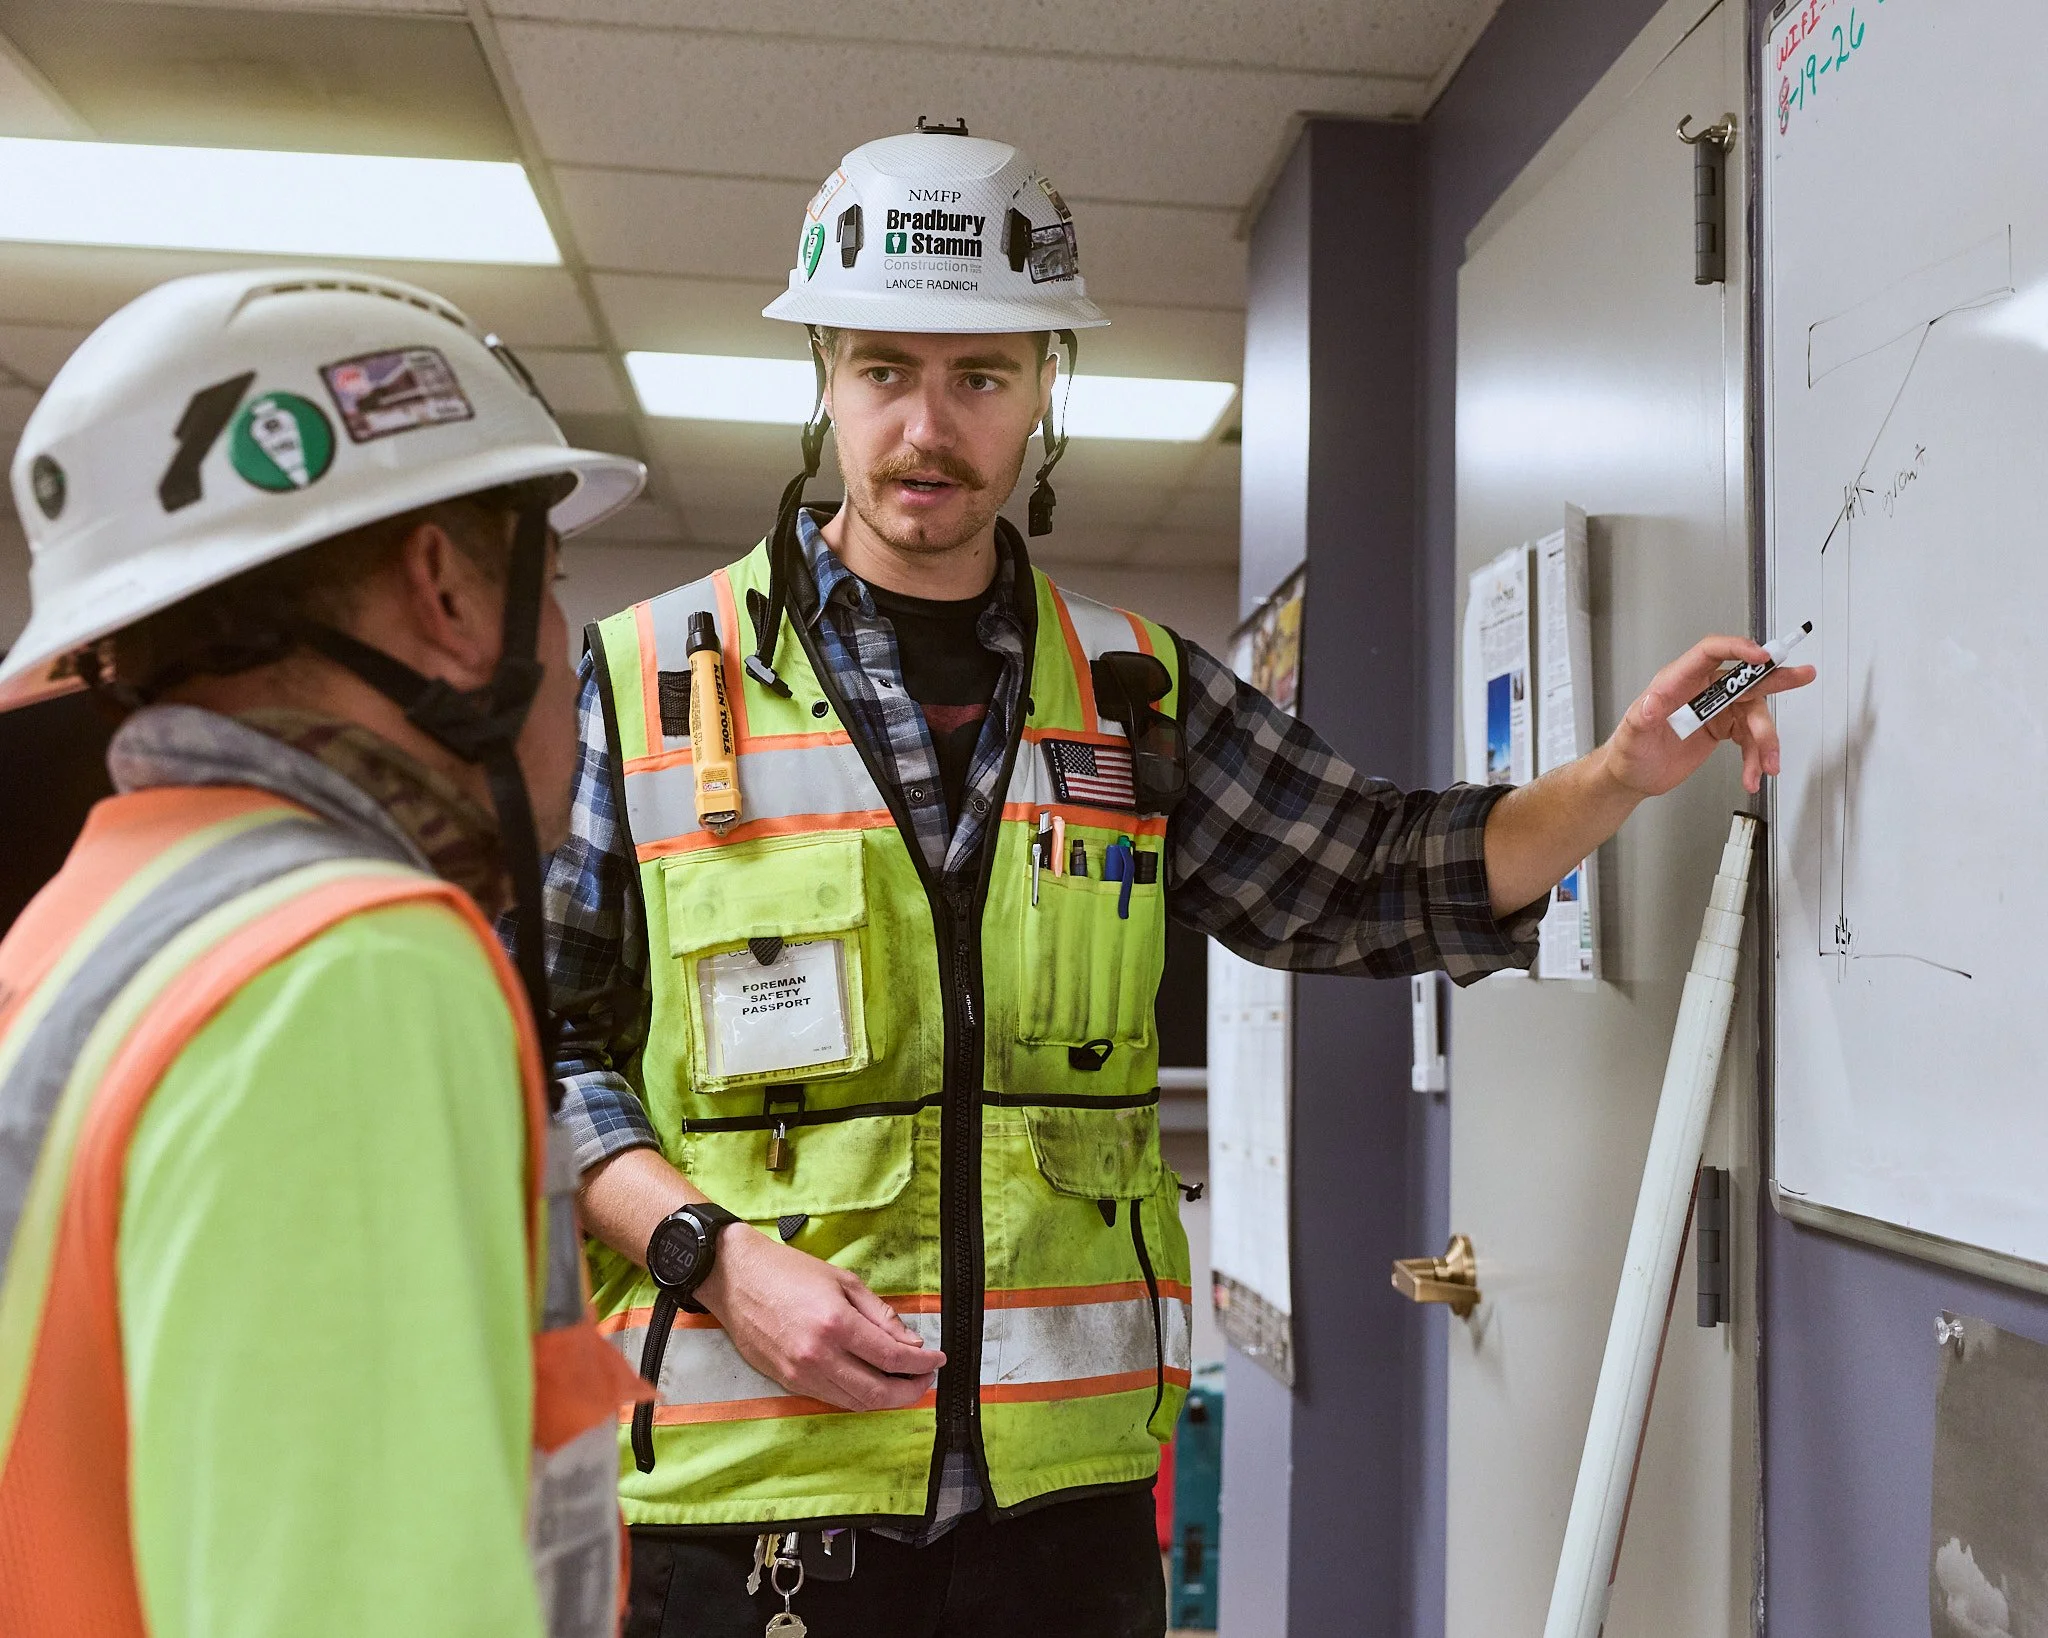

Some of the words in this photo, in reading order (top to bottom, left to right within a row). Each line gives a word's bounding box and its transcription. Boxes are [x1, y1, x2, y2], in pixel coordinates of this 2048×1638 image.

[908, 189, 962, 204] NMFP
[886, 209, 986, 237] Bradbury
[911, 232, 983, 258] Stamm
[884, 258, 969, 273] Construction
[886, 279, 923, 289] LANCE
[926, 279, 979, 291] RADNICH
[1726, 663, 1766, 694] EXPO
[713, 663, 727, 707] KLEIN
[720, 709, 732, 755] TOOLS
[1049, 742, 1068, 799] KISHIGO
[742, 975, 807, 993] FOREMAN
[750, 987, 801, 1003] SAFETY
[742, 997, 812, 1016] PASSPORT
